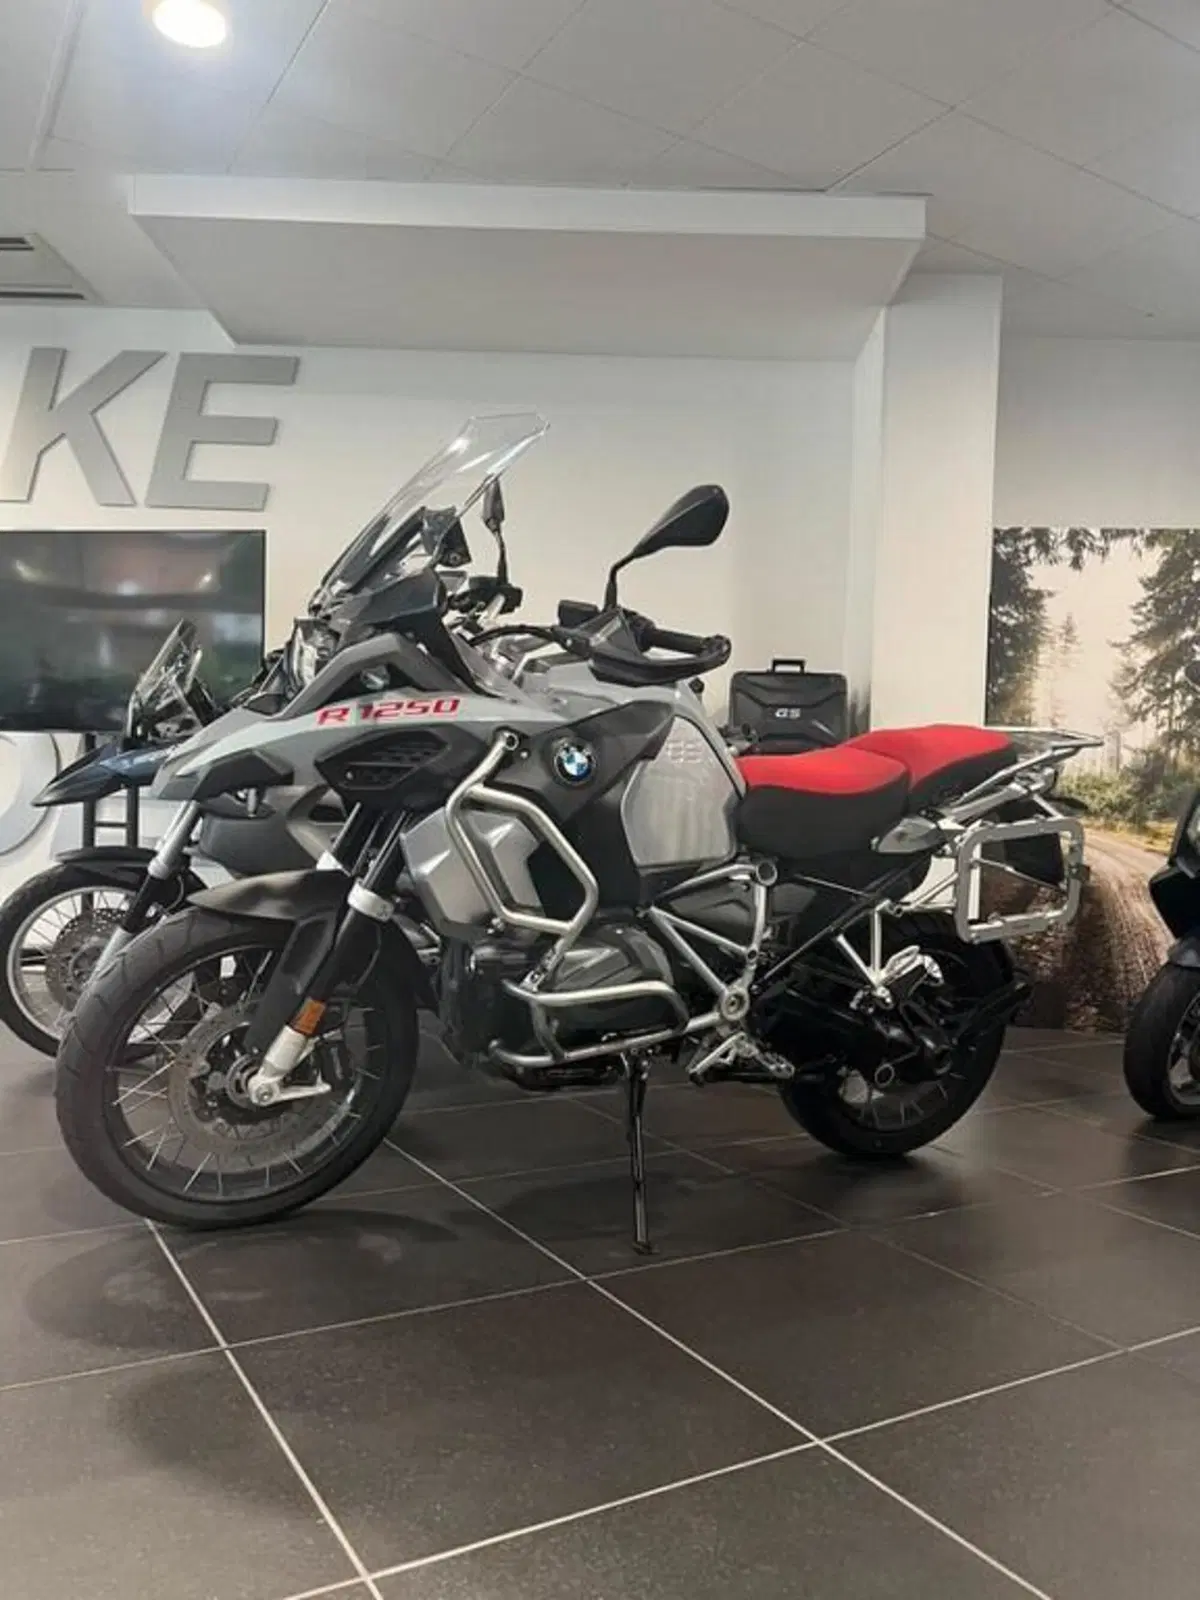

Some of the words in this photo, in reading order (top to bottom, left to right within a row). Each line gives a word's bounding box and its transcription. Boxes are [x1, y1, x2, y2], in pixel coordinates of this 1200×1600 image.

[0, 346, 299, 511] KE
[317, 707, 350, 725] R
[358, 698, 461, 720] 1250
[775, 708, 801, 719] GS
